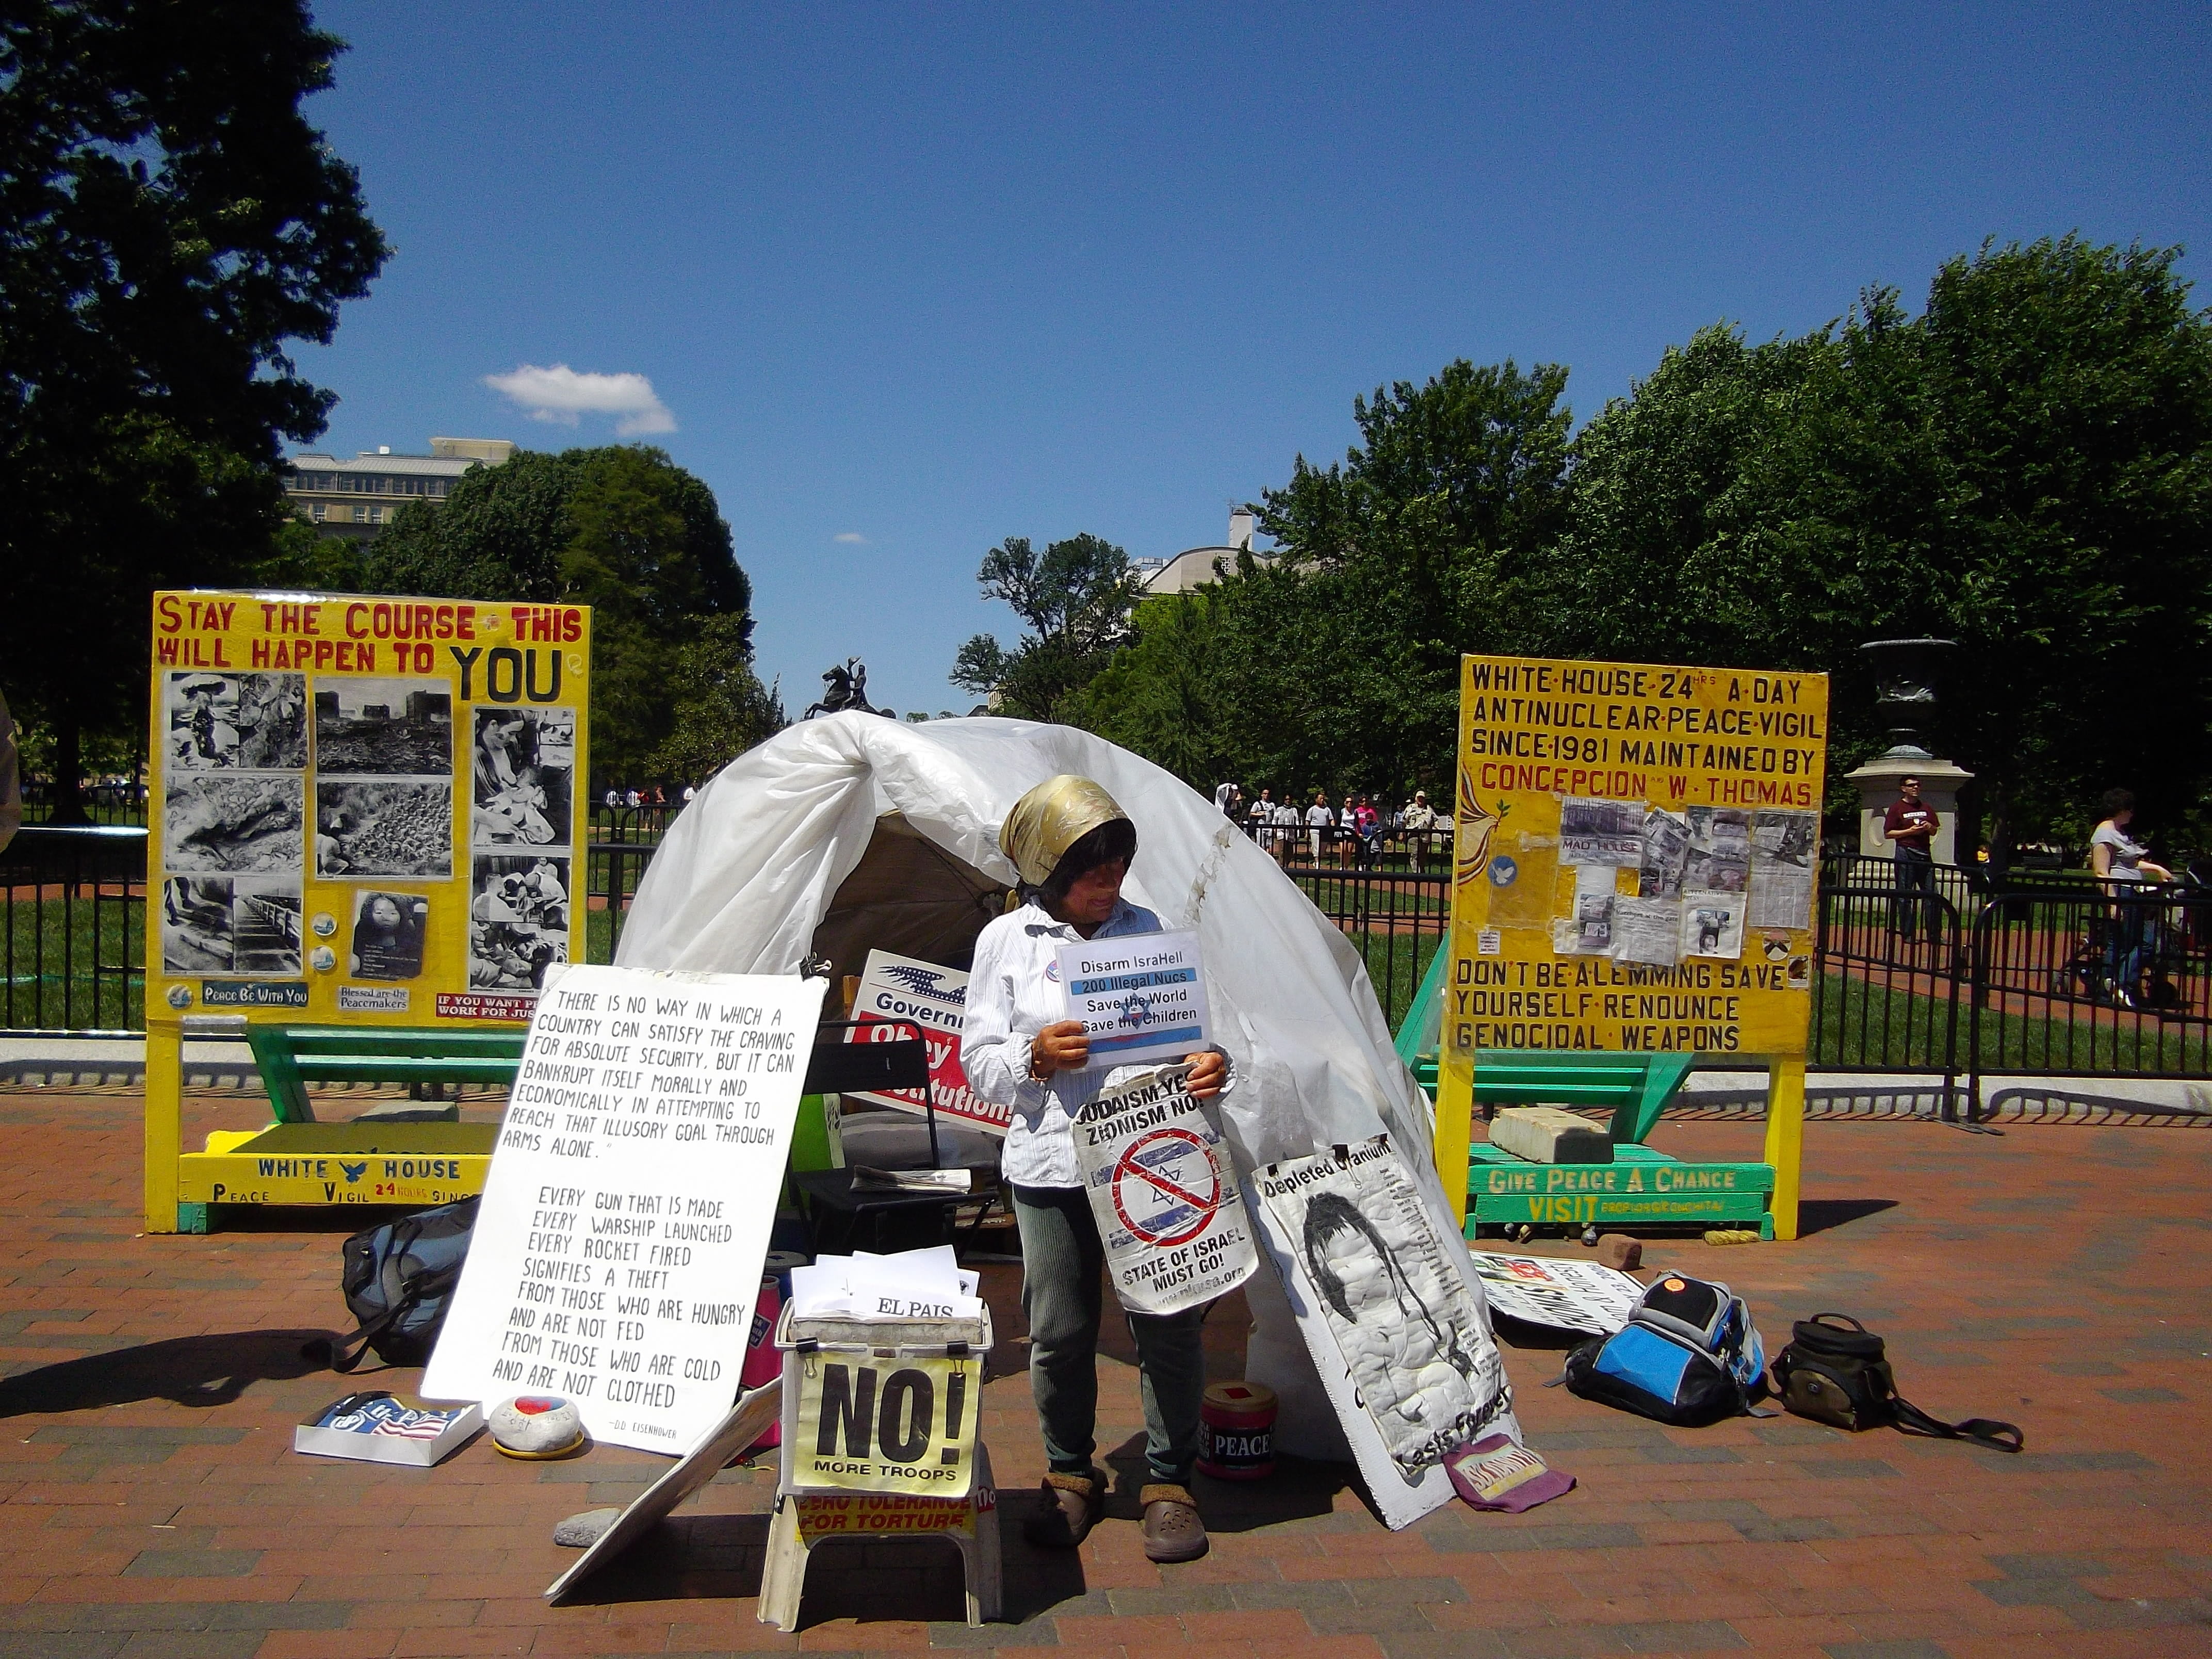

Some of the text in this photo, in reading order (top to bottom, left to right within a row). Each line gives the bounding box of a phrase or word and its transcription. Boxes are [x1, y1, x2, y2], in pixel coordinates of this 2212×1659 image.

[158, 596, 582, 642] STAY THE COURSE THIS
[158, 638, 562, 702] WILL HAPPEN TO YOU
[1472, 663, 1801, 705] WHITE HOUSE 24 A DAY
[1473, 696, 1822, 739] ANTINUCLEAR PEACE VIGIL
[1471, 728, 1815, 774] SINCE 1981 MAINTAINED BY
[1481, 762, 1811, 806] CONCEPCION THOMAS
[1563, 840, 1590, 850] MAD
[1081, 951, 1183, 973] Disarm IsraHell
[1456, 958, 1785, 990] DON'T BE A LEMMING SAVE
[341, 988, 373, 997] Blessed
[1083, 971, 1186, 993] 200 Illegal Nucs
[341, 997, 406, 1008] Peacemakers
[438, 1006, 508, 1016] WORK FOR
[455, 997, 480, 1005] YOU
[485, 998, 521, 1007] WANT
[558, 990, 781, 1026] THERE IS NO WAY IN WHICH A
[1087, 989, 1187, 1012] Save the World
[1457, 990, 1740, 1021] YOURSELF RENOUNCE
[538, 1014, 795, 1051] COUNTRY CAN SATISFY THE CRAVING
[1083, 1008, 1196, 1033] Save the Children
[1456, 1022, 1739, 1051] GENOCIDAL WEAPONS
[531, 1035, 560, 1055] FOR
[564, 1040, 630, 1063] ABSOLUTE
[716, 1052, 742, 1071] BUT
[747, 1053, 762, 1072] IT
[767, 1053, 794, 1072] CAN
[523, 1059, 747, 1096] BANKRUPT ITSELF MORALLY AND
[517, 1084, 760, 1120] ECONOMICALLY IN ATTEMPTING TO
[1075, 1087, 1158, 1125] JUDAISM
[509, 1107, 774, 1145] REACH THAT ILLUSORY GOAL THROUGH
[1086, 1095, 1204, 1146] ZIONISM NO!
[502, 1130, 541, 1151] ARMS
[259, 1159, 460, 1179] WHITE HOUSE
[1264, 1158, 1335, 1197] Depleted
[1547, 1168, 1616, 1191] PEACE
[1625, 1167, 1645, 1192] A
[1655, 1166, 1736, 1191] CHANCE
[214, 1183, 395, 1202] PEACE VIGIL 24
[539, 1186, 723, 1219] EVERY GUN THAT IS MADE
[1528, 1196, 1598, 1223] VISIT
[532, 1210, 732, 1243] EVERY WARSHIP LAUNCHED
[528, 1232, 691, 1266] EVERY ROCKET FIRED
[1123, 1227, 1246, 1286] STATE OF ISRAEL
[523, 1257, 669, 1289] SIGNIFIES A THEFT
[1152, 1251, 1225, 1294] MUST GO!
[517, 1280, 745, 1325] FROM THOSE WHO ARE HUNGRY
[877, 1297, 954, 1318] EL PAIS
[509, 1307, 644, 1341] AND ARE NOT FED
[502, 1331, 721, 1381] FROM THOSE WHO ARE COLD
[492, 1358, 675, 1408] AND ARE NOT CLOTHED
[632, 1423, 678, 1438] EISENHOWER
[817, 1362, 966, 1466] NO!
[1215, 1434, 1270, 1456] PEACE
[815, 1460, 956, 1481] MORE TROOPS
[801, 1514, 966, 1529] FOR TORTURE
